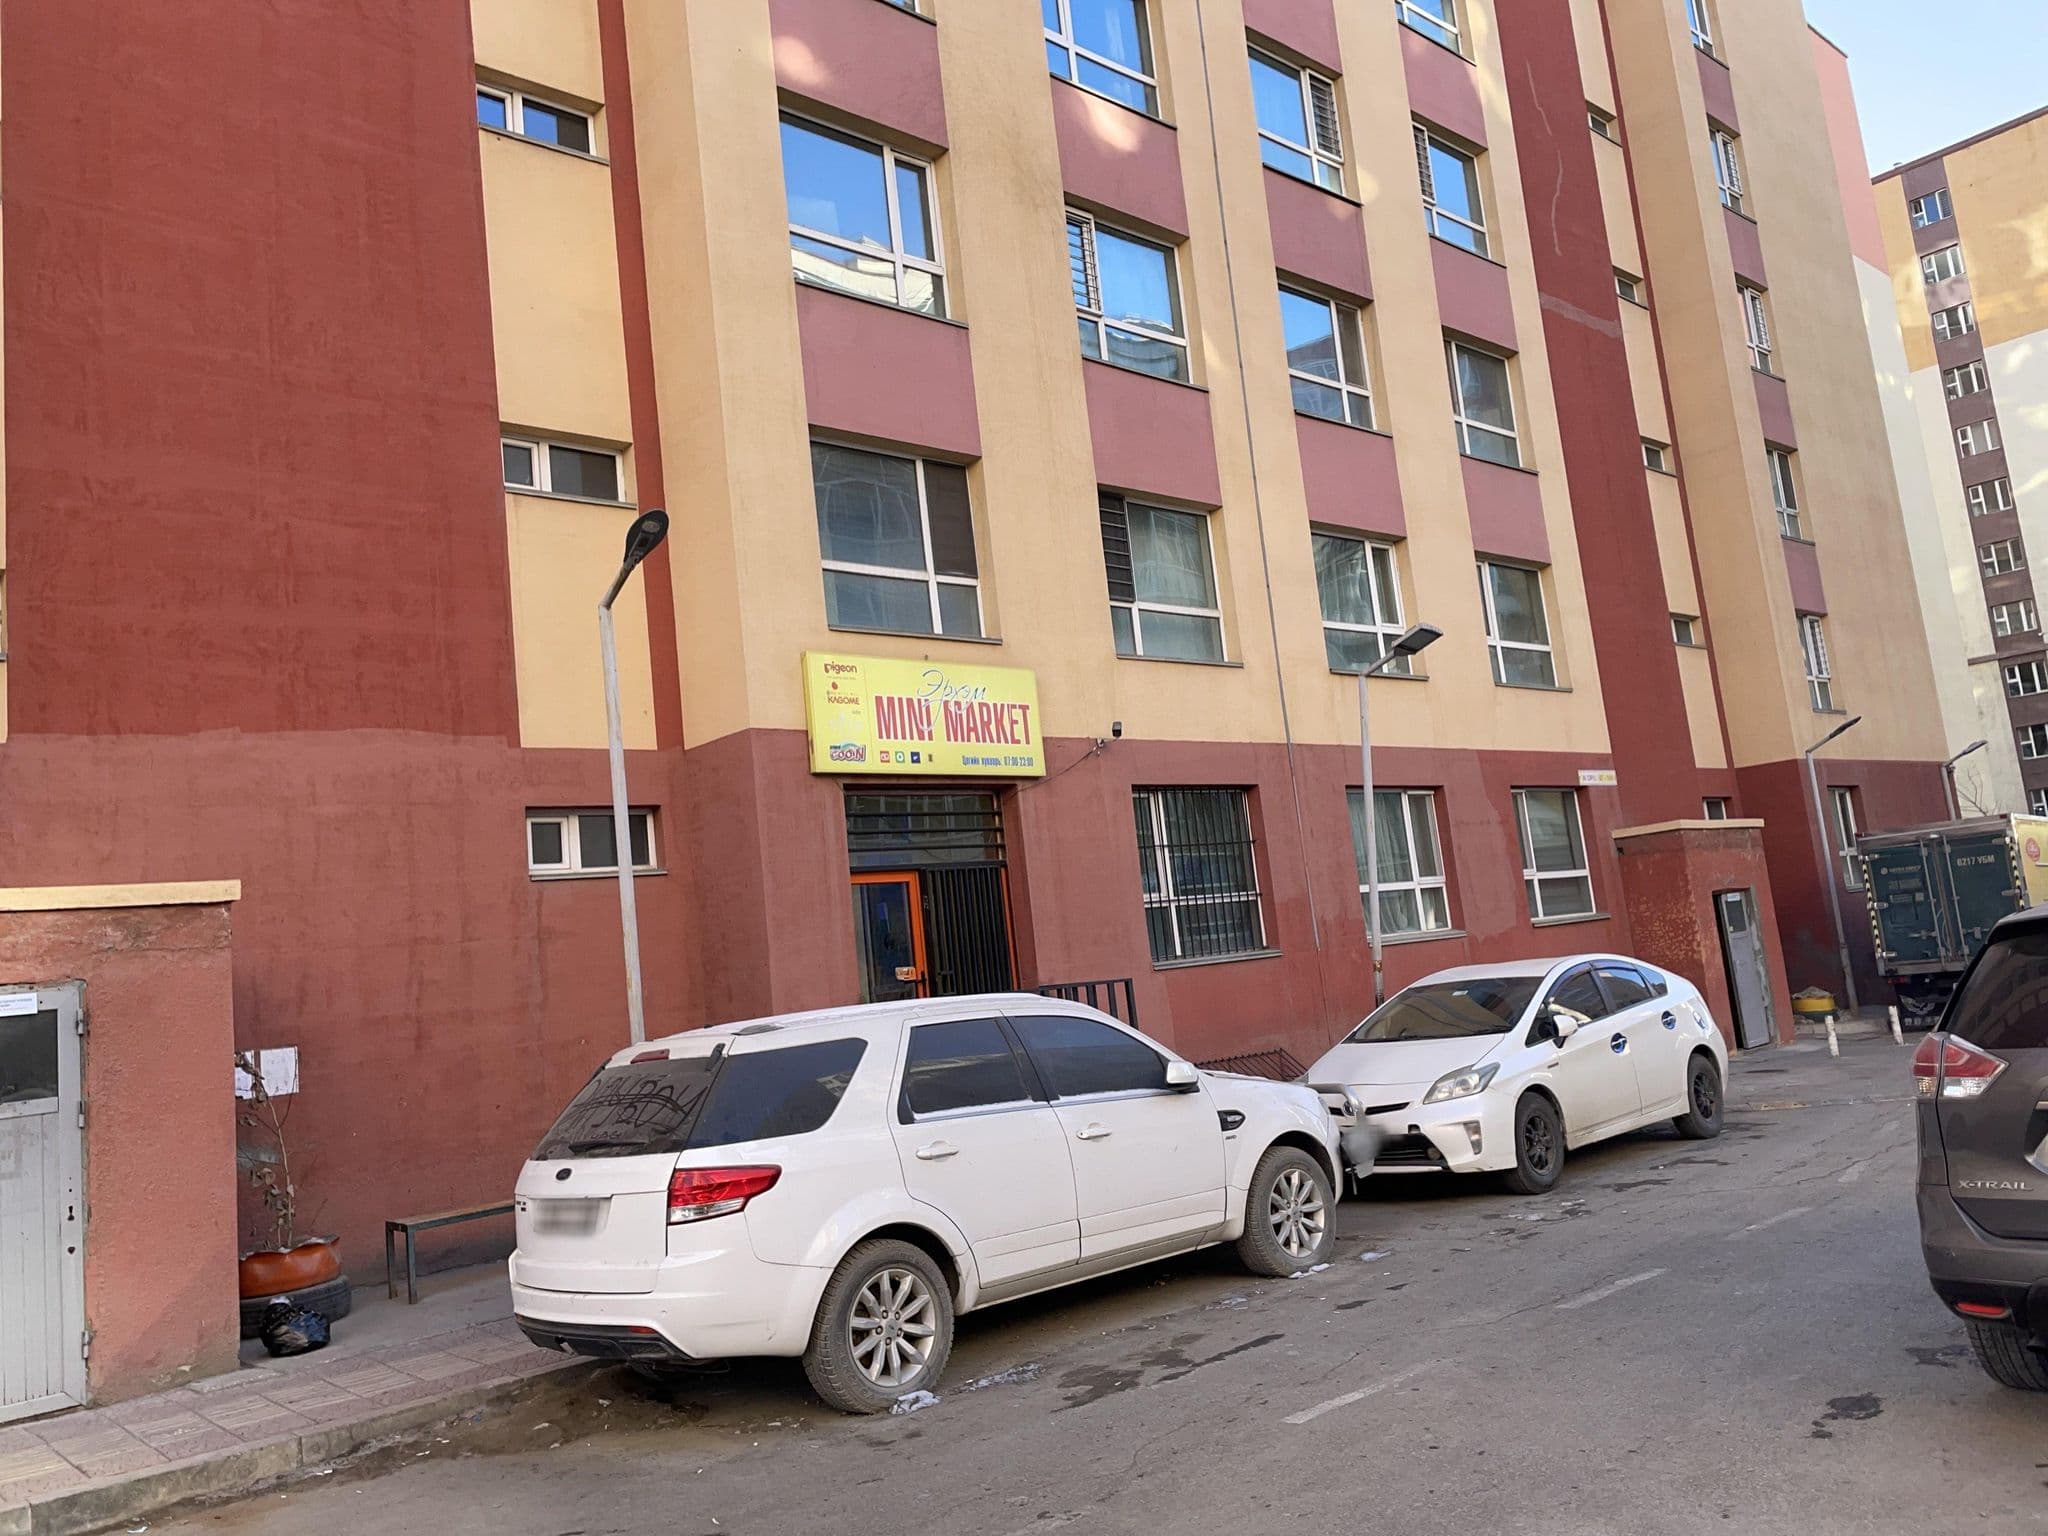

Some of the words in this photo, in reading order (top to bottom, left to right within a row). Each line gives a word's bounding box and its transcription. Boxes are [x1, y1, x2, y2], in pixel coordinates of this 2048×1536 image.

[824, 661, 858, 674] pigeon
[827, 696, 860, 705] KAGOME
[875, 695, 934, 741] MINI
[943, 699, 1031, 745] MARKET
[1959, 1180, 2033, 1191] X-TRAIL
